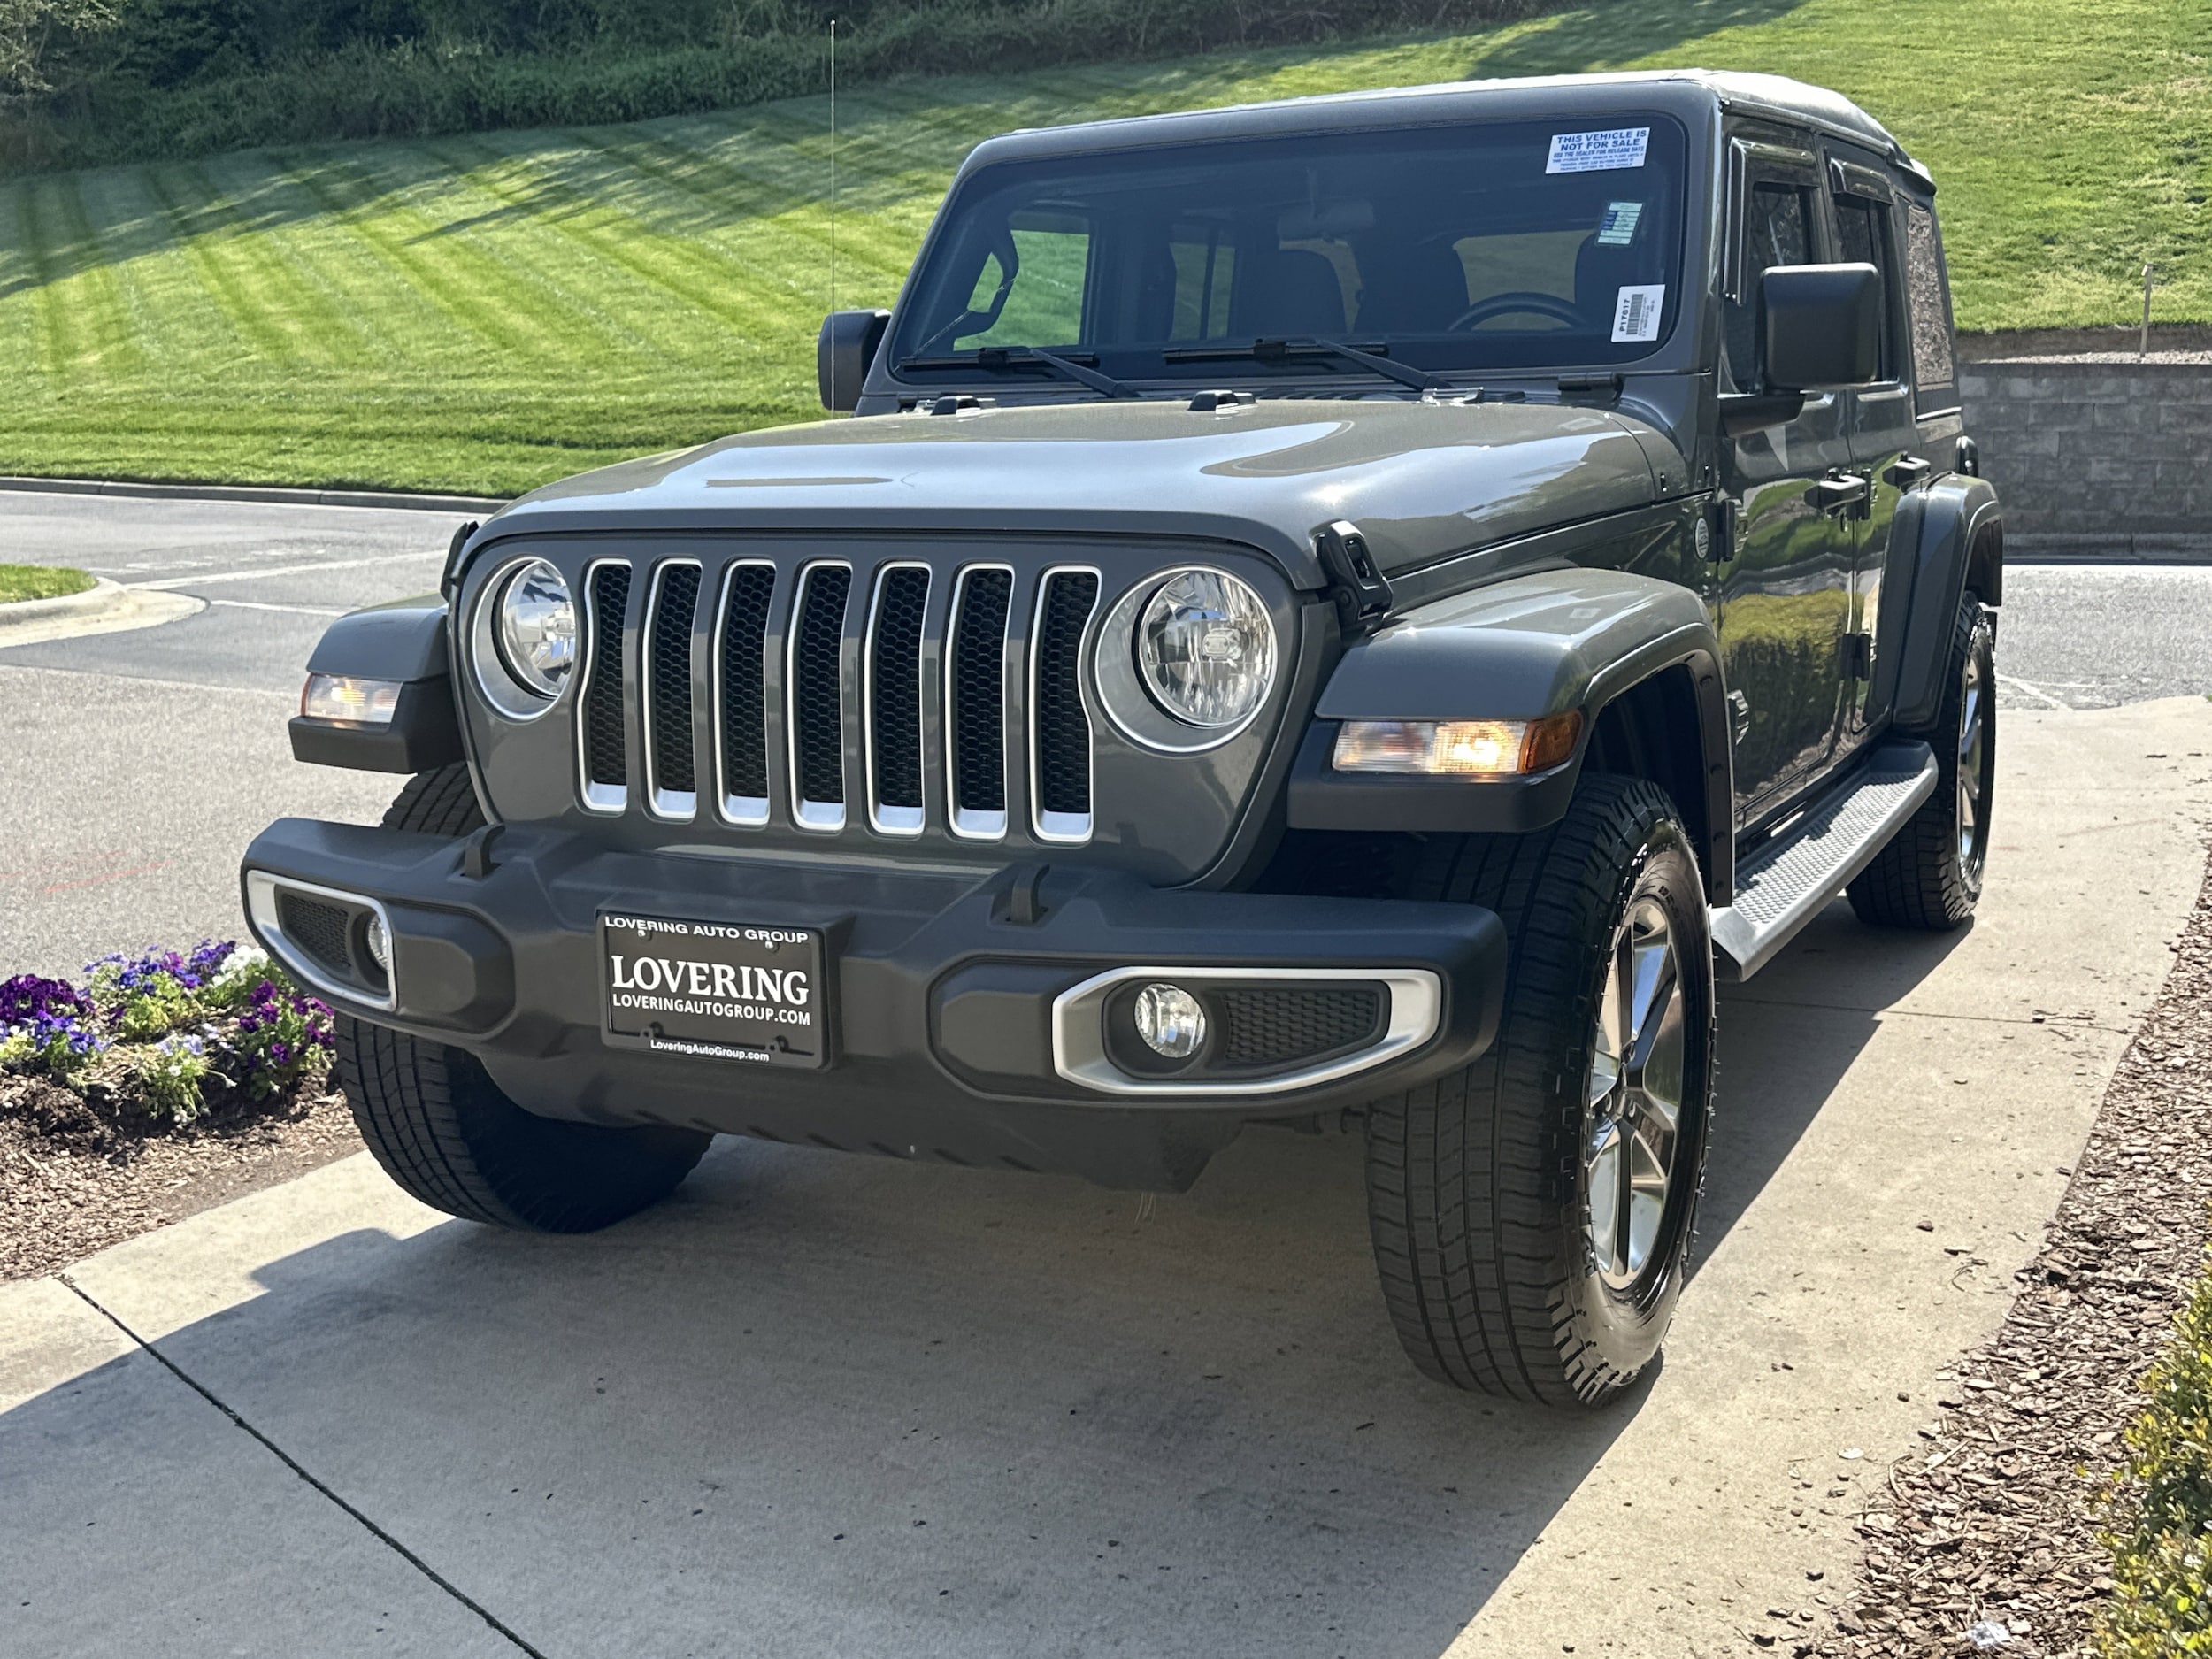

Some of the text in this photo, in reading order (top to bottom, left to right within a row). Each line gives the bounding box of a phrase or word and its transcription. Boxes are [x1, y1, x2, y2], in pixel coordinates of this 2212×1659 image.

[1586, 131, 1632, 141] VEHICLE
[1612, 138, 1640, 147] SALE
[604, 916, 809, 944] LOVERING AUTO GROUP
[611, 955, 810, 1006] LOVERING
[612, 993, 810, 1026] LOVERINGAUTOGROUP.COM
[650, 1039, 770, 1063] LoveringAutoGroup.com
